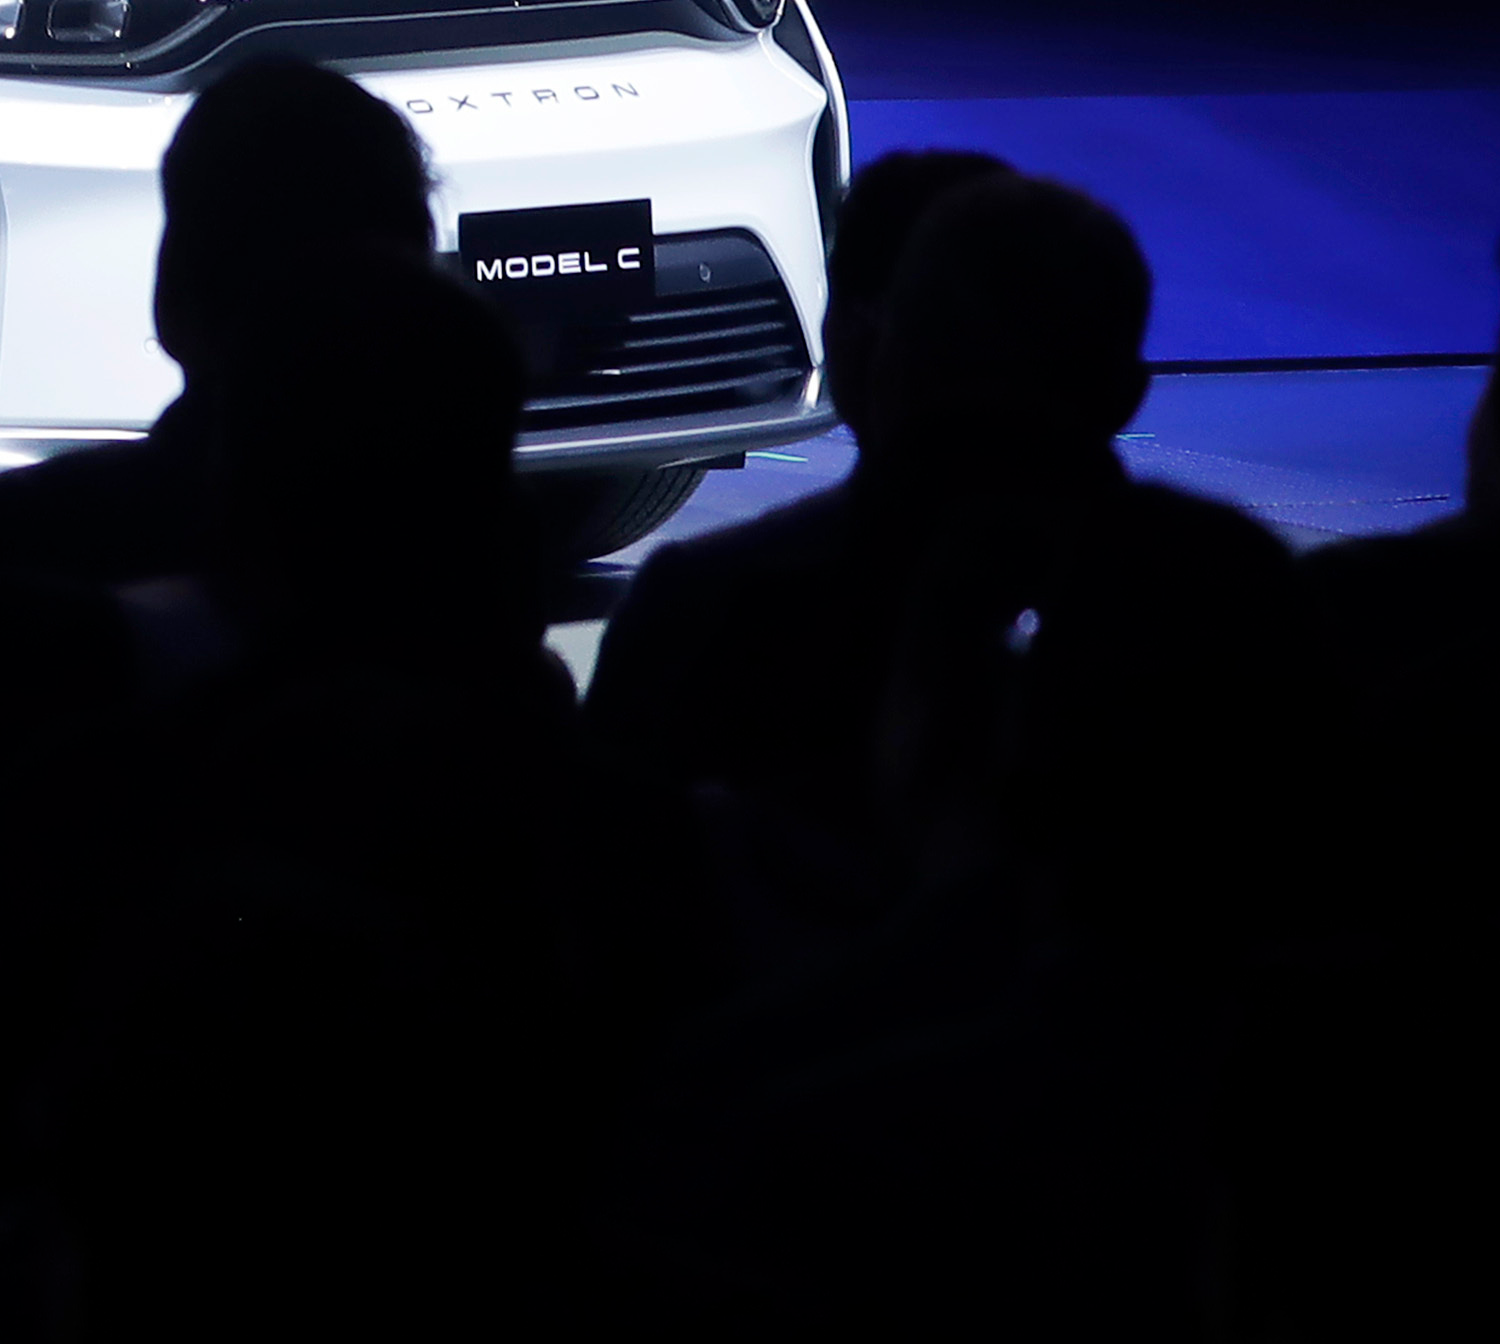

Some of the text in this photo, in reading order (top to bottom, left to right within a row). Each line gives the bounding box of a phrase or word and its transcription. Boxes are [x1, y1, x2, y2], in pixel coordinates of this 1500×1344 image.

[405, 82, 640, 114] OXTRON
[476, 247, 641, 281] MODEL C
